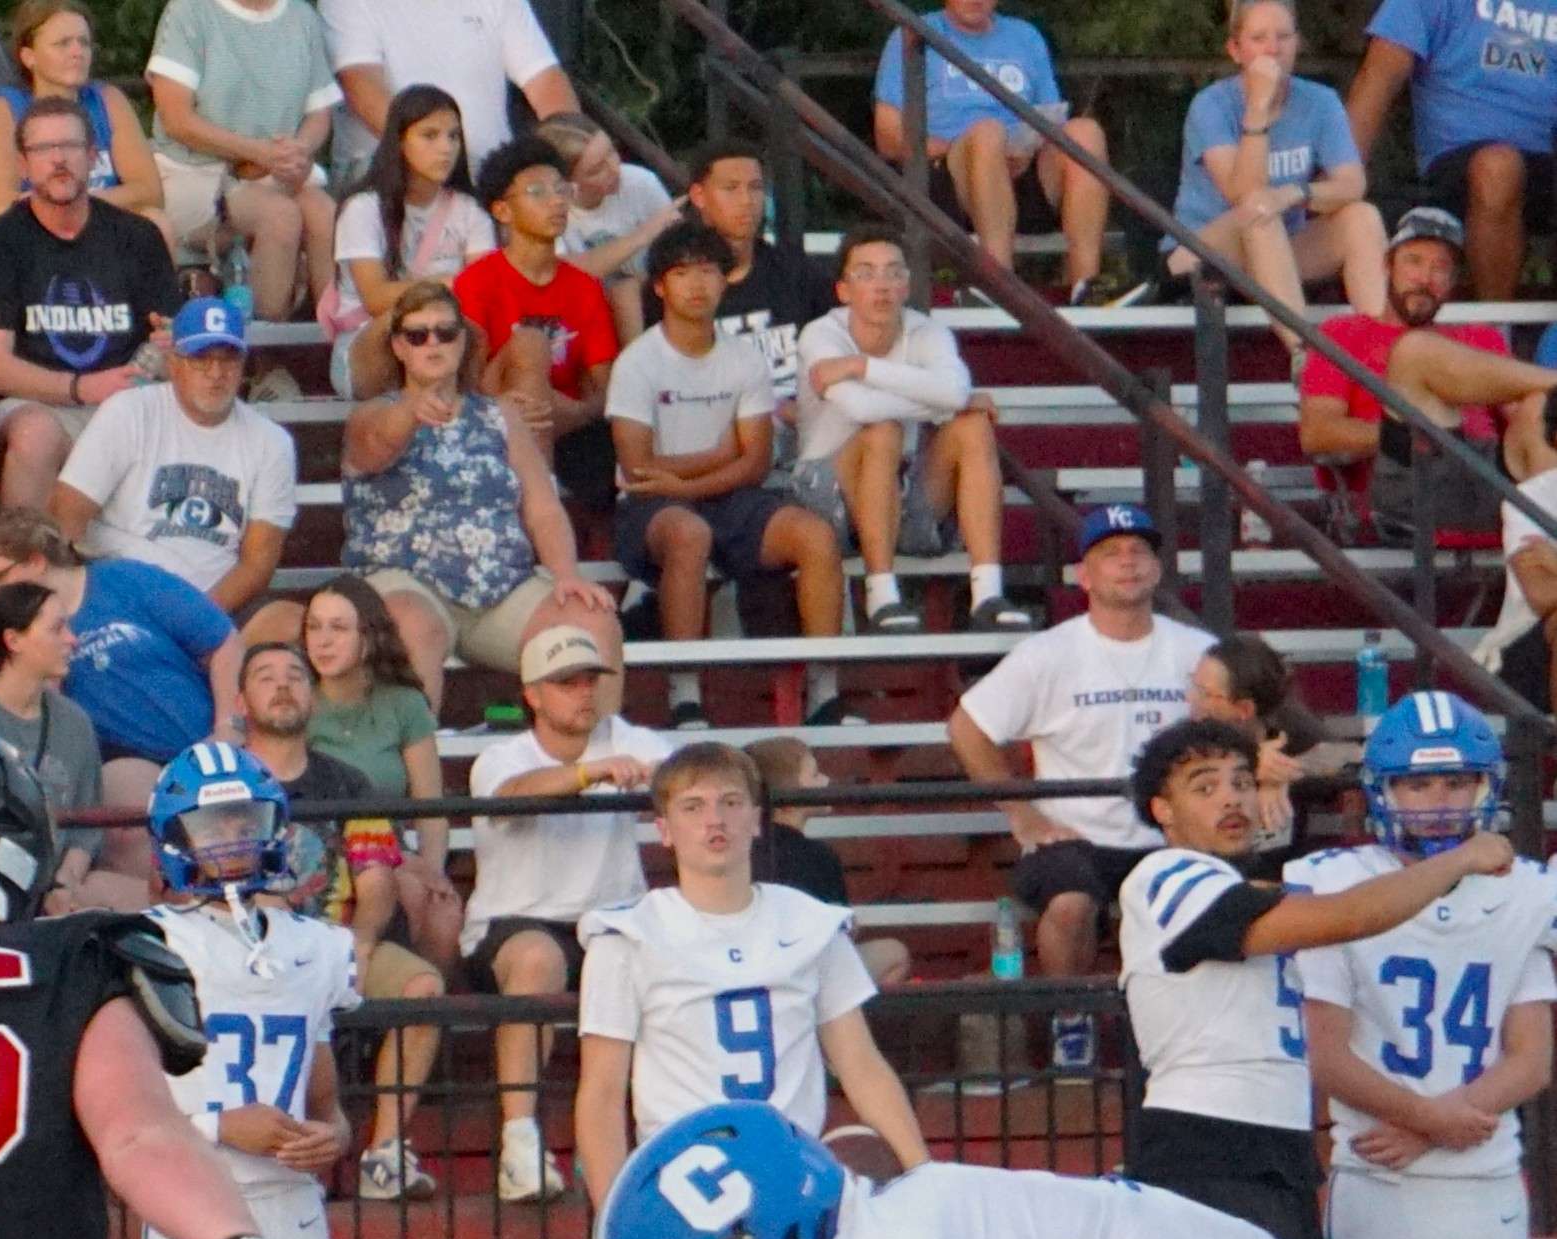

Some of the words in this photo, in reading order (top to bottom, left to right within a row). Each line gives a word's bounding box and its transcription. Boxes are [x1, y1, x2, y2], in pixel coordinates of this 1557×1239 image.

[1483, 40, 1546, 75] DAY
[25, 303, 132, 333] INDIANS
[205, 307, 227, 332] C
[1107, 505, 1135, 529] KC
[1072, 688, 1189, 708] FLEISCHMAN
[1134, 711, 1163, 726] #13
[1437, 905, 1451, 922] C
[728, 948, 743, 963] C
[1379, 954, 1494, 1083] 34
[716, 985, 777, 1102] 9
[205, 1012, 308, 1113] 37
[658, 1143, 753, 1232] C
